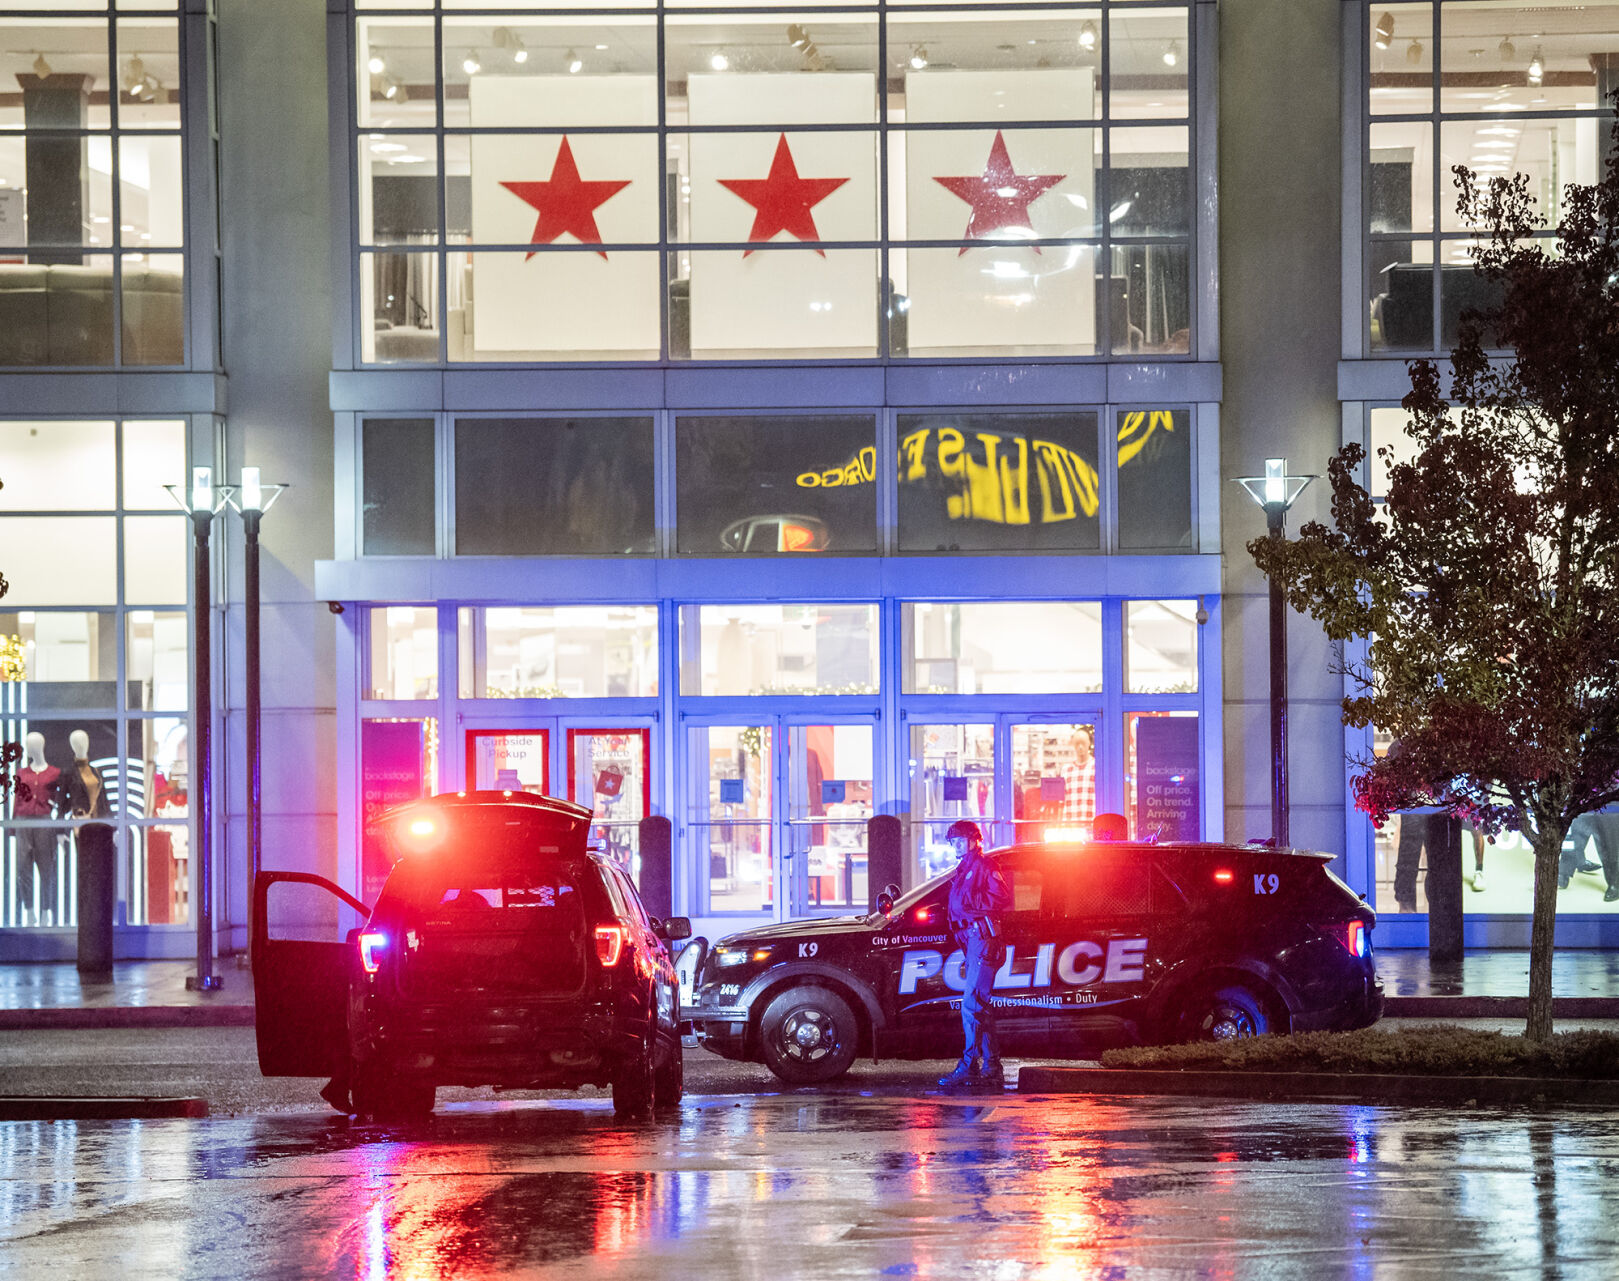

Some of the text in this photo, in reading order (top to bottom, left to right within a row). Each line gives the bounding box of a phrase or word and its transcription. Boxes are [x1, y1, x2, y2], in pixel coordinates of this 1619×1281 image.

[481, 737, 533, 746] Curbside
[588, 737, 602, 746] At
[488, 750, 527, 760] Pickup
[588, 749, 630, 758] Service
[1146, 784, 1193, 796] Off price.
[1146, 796, 1194, 807] On trend.
[1146, 808, 1187, 820] Arriving
[1253, 873, 1280, 895] K9
[872, 934, 948, 946] City of Vancouver
[798, 942, 819, 958] K9
[990, 993, 1098, 1008] rofessionalism Duty
